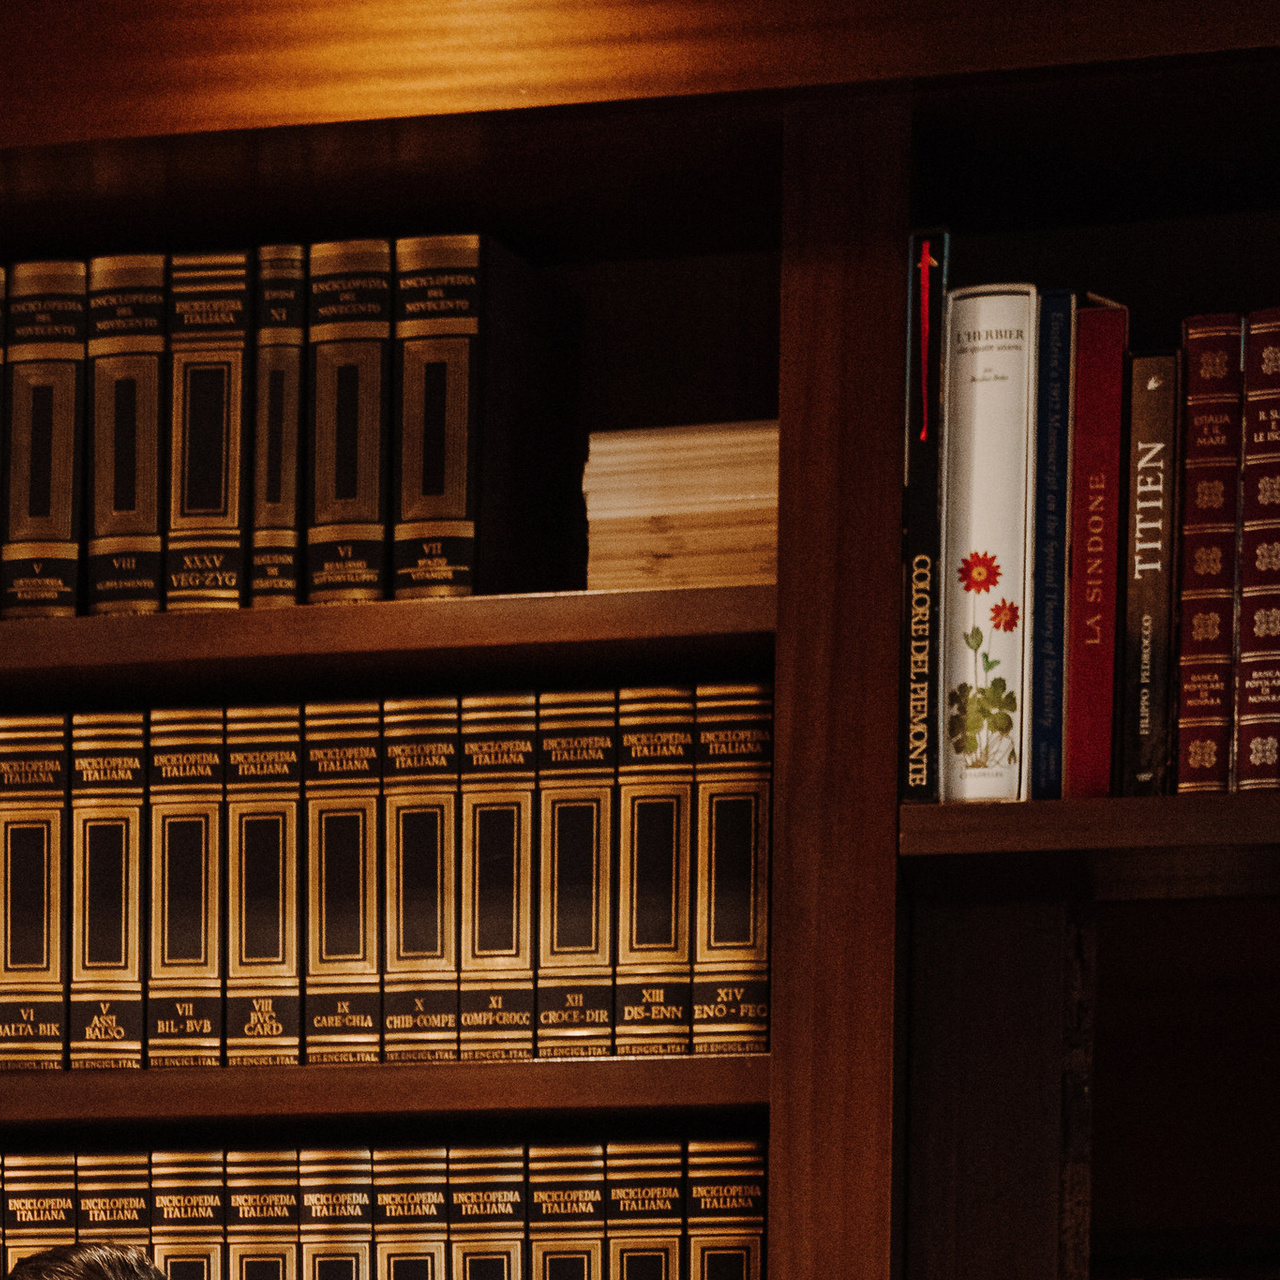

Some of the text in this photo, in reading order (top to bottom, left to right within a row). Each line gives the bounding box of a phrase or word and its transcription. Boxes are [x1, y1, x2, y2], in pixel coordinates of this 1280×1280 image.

[1133, 440, 1166, 580] TITIEN
[1084, 473, 1106, 646] LA SINDONE
[908, 554, 931, 787] COLORE DEL PIEMONTE
[551, 748, 604, 761] ITALIANA
[161, 765, 212, 778] ITALIANA
[318, 759, 369, 772] ITALIANA
[565, 994, 583, 1007] XII
[642, 989, 664, 1002] XIII
[716, 988, 744, 1002] XIV
[100, 1003, 110, 1014] V
[253, 999, 272, 1011] VIII
[337, 1001, 350, 1013] IX
[415, 998, 424, 1012] X
[489, 996, 502, 1009] XI
[20, 1008, 34, 1021] VI
[175, 1003, 193, 1016] VII
[623, 1006, 682, 1020] DIS-ENN
[250, 1012, 276, 1024] BVC
[540, 1009, 608, 1024] CROCE-DIR
[85, 1026, 125, 1039] BALSO
[244, 1023, 283, 1036] CARD
[533, 1190, 602, 1203] ENCICLOPEDIA
[611, 1187, 679, 1200] ENCICLOPEDIA
[156, 1195, 220, 1207] ENCICLOPEDIA
[231, 1194, 296, 1207] ENCICLOPEDIA
[620, 1199, 672, 1211] ITALIANA
[163, 1207, 213, 1218] ITALIANA
[239, 1207, 289, 1217] ITALIANA
[542, 1202, 594, 1214] ITALIANA
